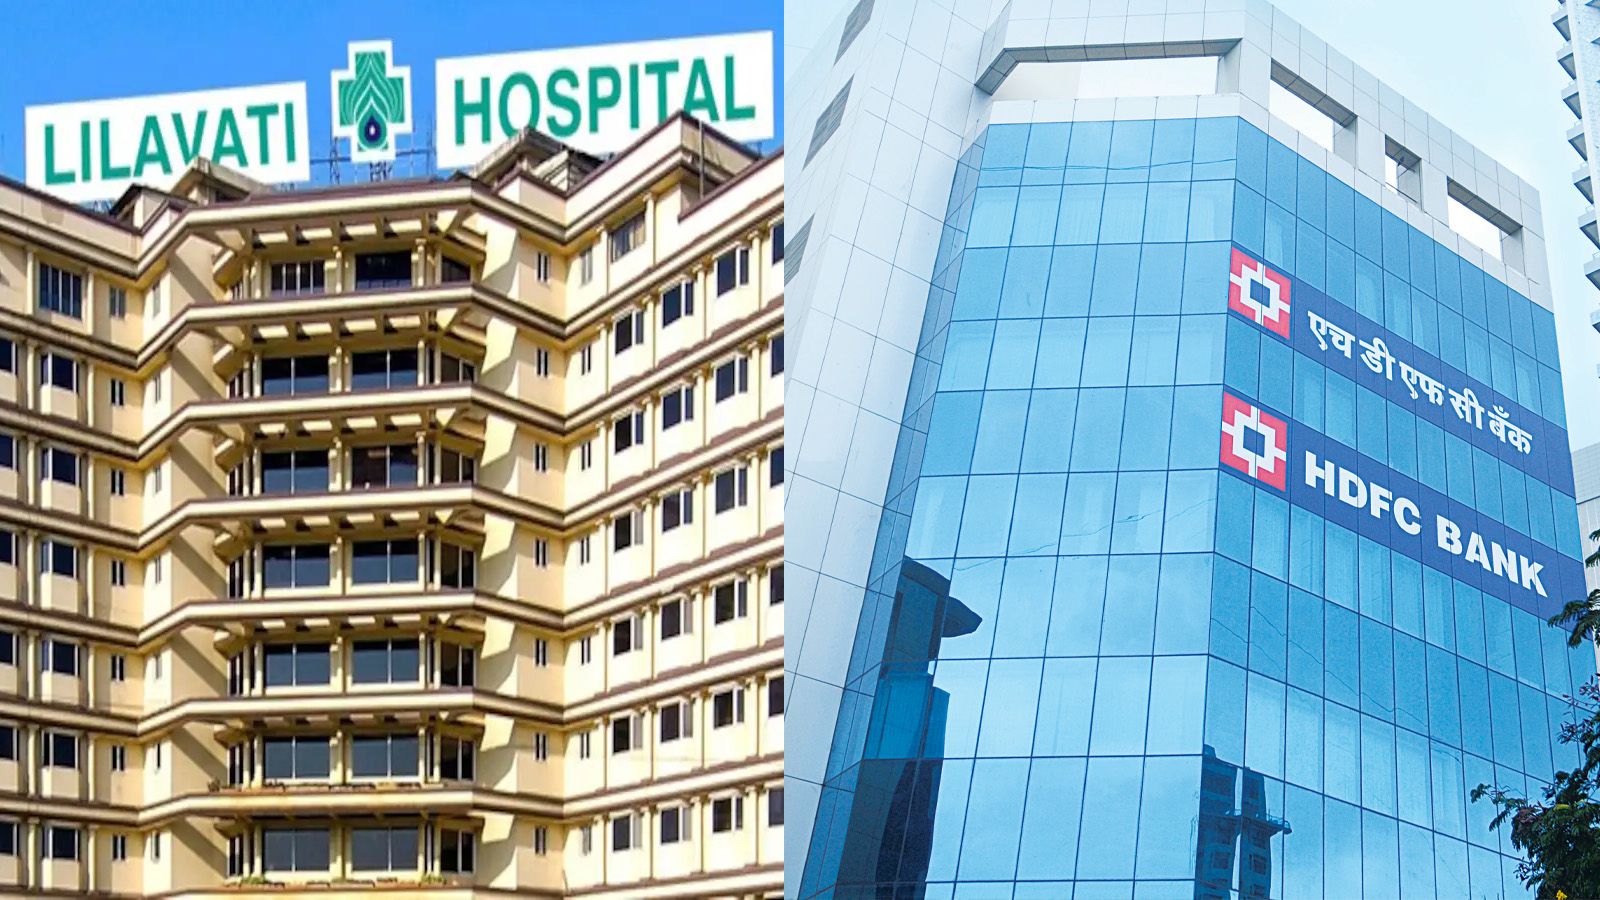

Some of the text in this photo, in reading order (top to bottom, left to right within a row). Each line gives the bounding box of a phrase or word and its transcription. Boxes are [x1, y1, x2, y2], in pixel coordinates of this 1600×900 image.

[44, 102, 296, 185] LILAVATI
[454, 55, 756, 146] HOSPITAL
[1307, 310, 1355, 359] एच
[1359, 337, 1396, 380] डी
[1399, 360, 1445, 406] एफ
[1448, 387, 1485, 430] सी
[1304, 450, 1548, 598] HDFC BANK
